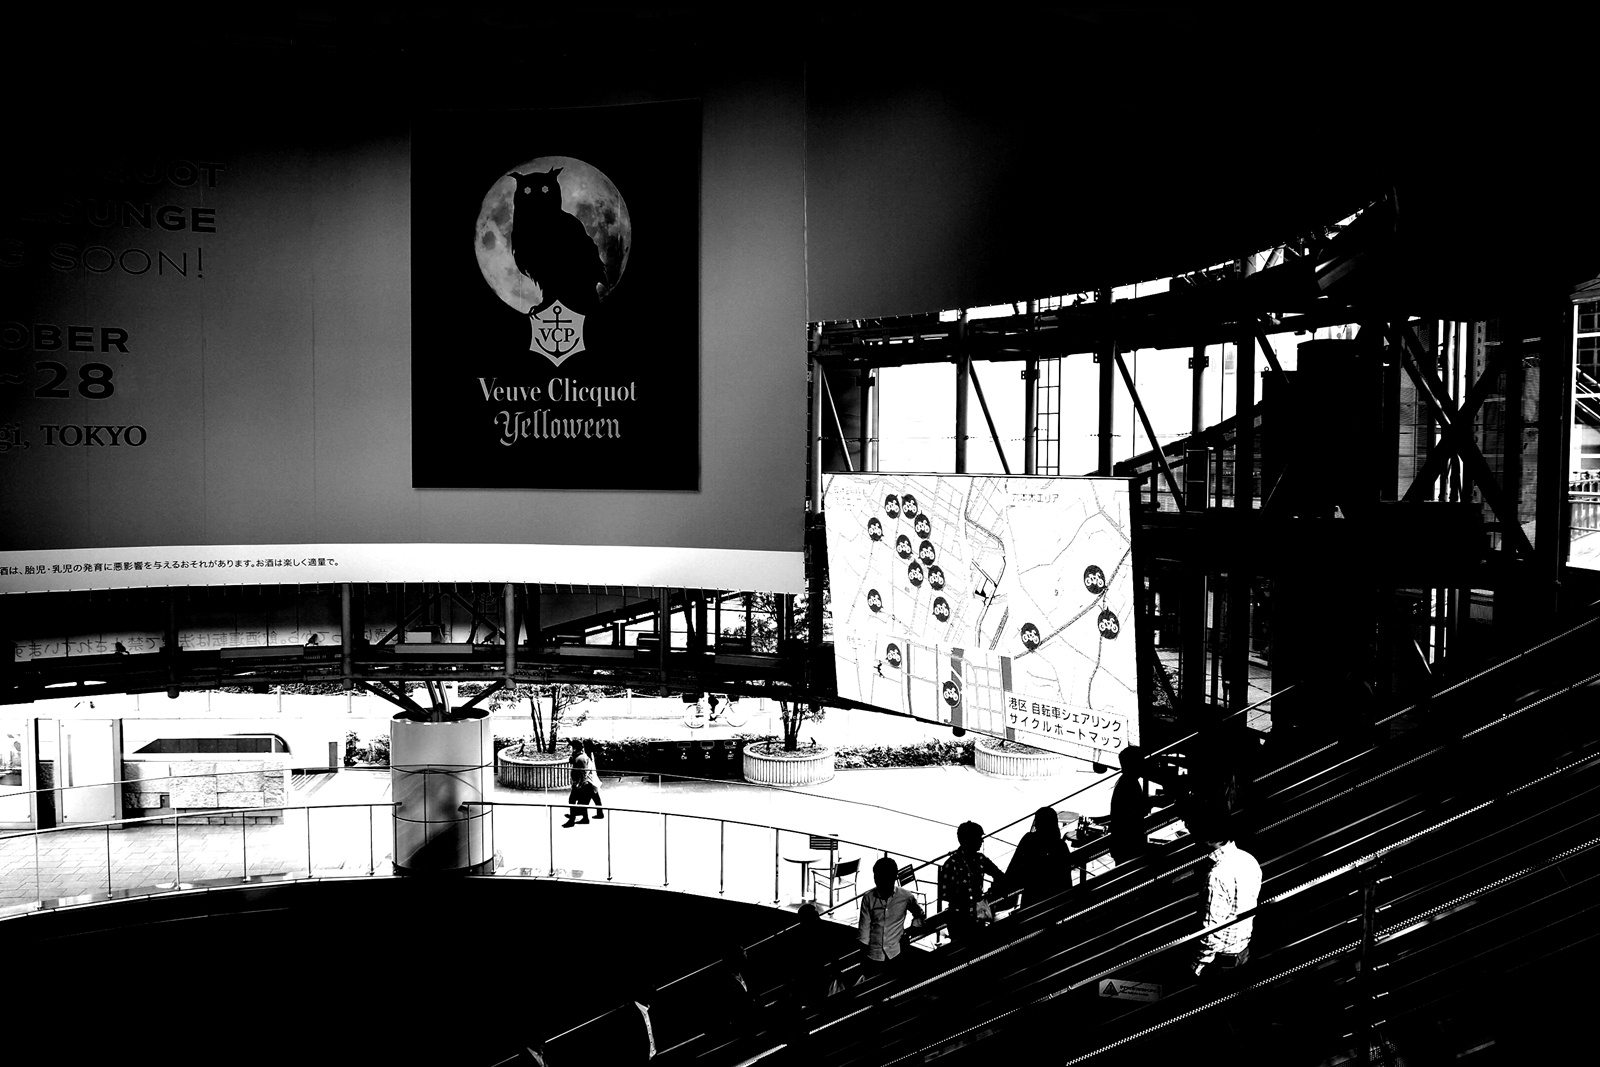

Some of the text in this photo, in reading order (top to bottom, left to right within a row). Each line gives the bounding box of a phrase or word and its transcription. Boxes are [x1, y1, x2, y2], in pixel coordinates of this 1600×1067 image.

[50, 242, 203, 279] SOON!
[539, 327, 575, 343] VCP
[477, 377, 638, 407] Veuve Clicquot
[40, 424, 147, 447] TOKYO
[494, 408, 622, 446] Yelloween
